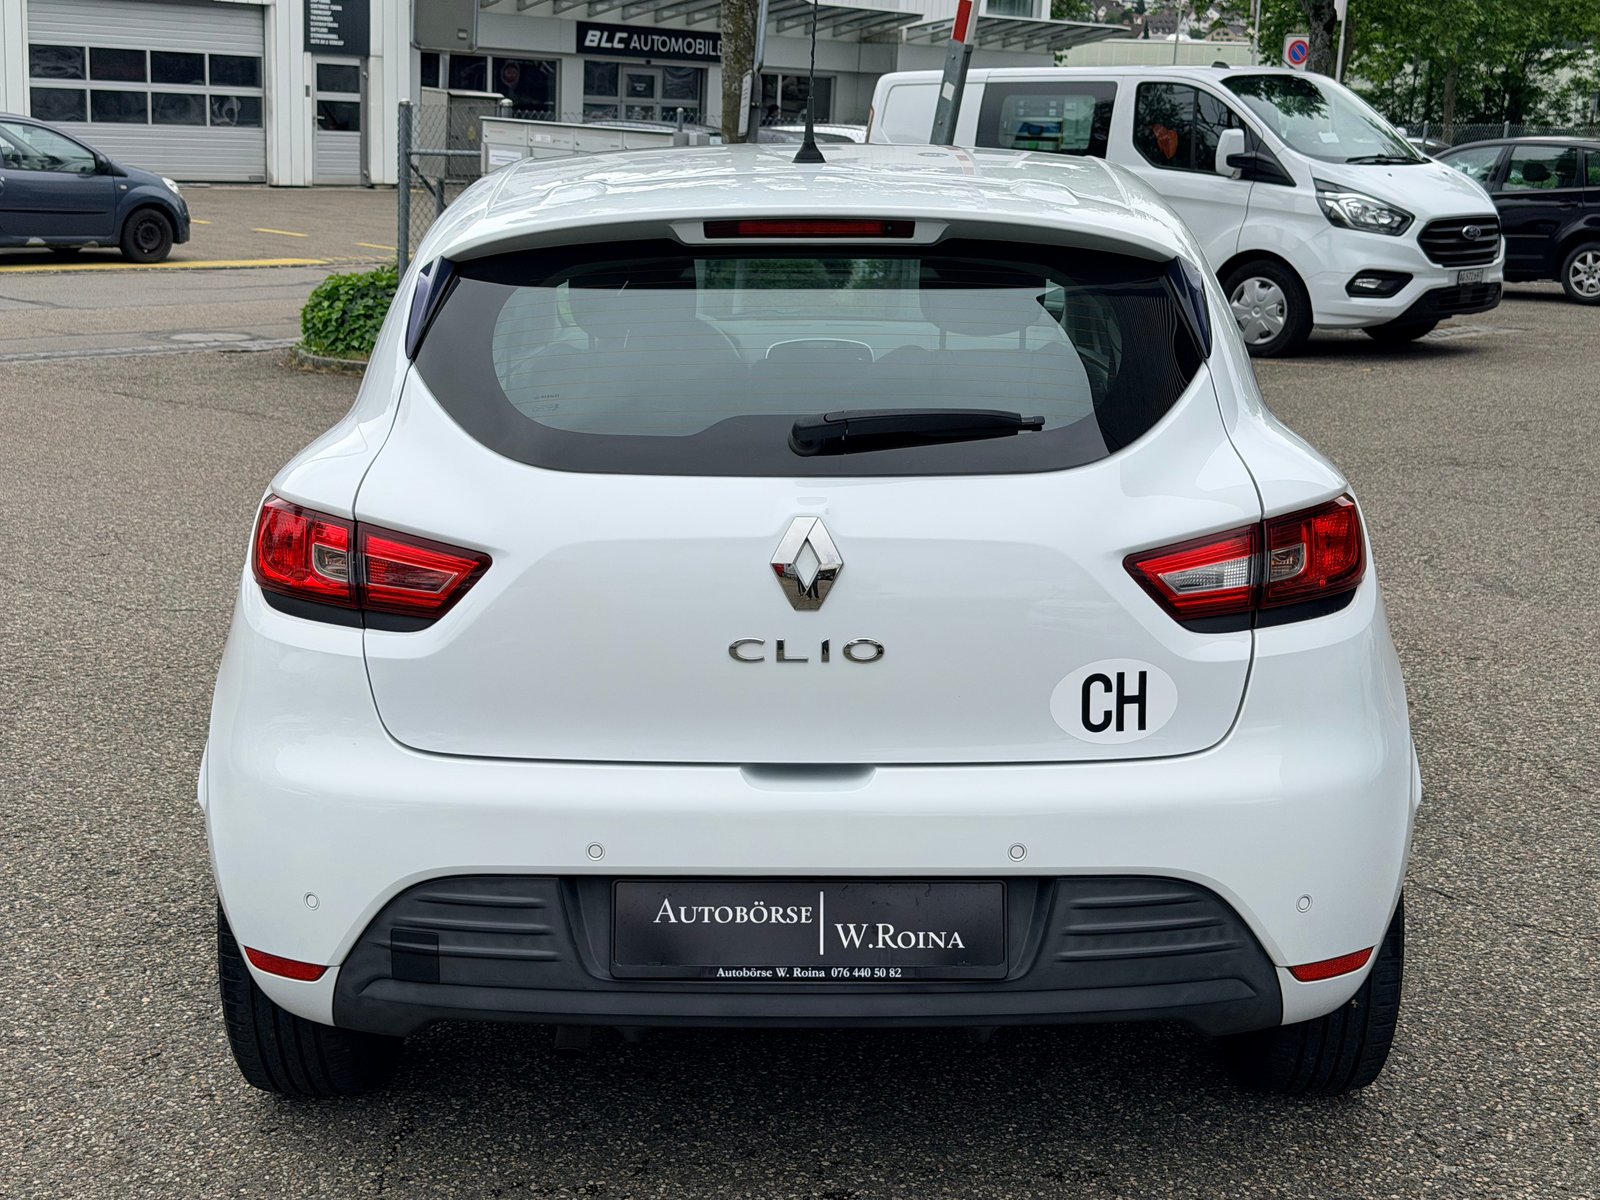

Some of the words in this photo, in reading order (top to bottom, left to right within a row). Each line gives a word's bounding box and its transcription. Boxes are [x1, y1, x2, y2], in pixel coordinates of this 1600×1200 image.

[584, 30, 628, 48] BLC
[728, 637, 885, 663] CLIO
[1082, 671, 1147, 733] CH
[653, 898, 813, 924] AUTOBÖRSE
[716, 967, 773, 978] Autobörse
[776, 967, 790, 978] W.
[793, 967, 826, 978] Roina
[831, 967, 850, 978] 076
[852, 967, 871, 978] 440
[873, 967, 887, 978] 50
[888, 967, 902, 978] 82
